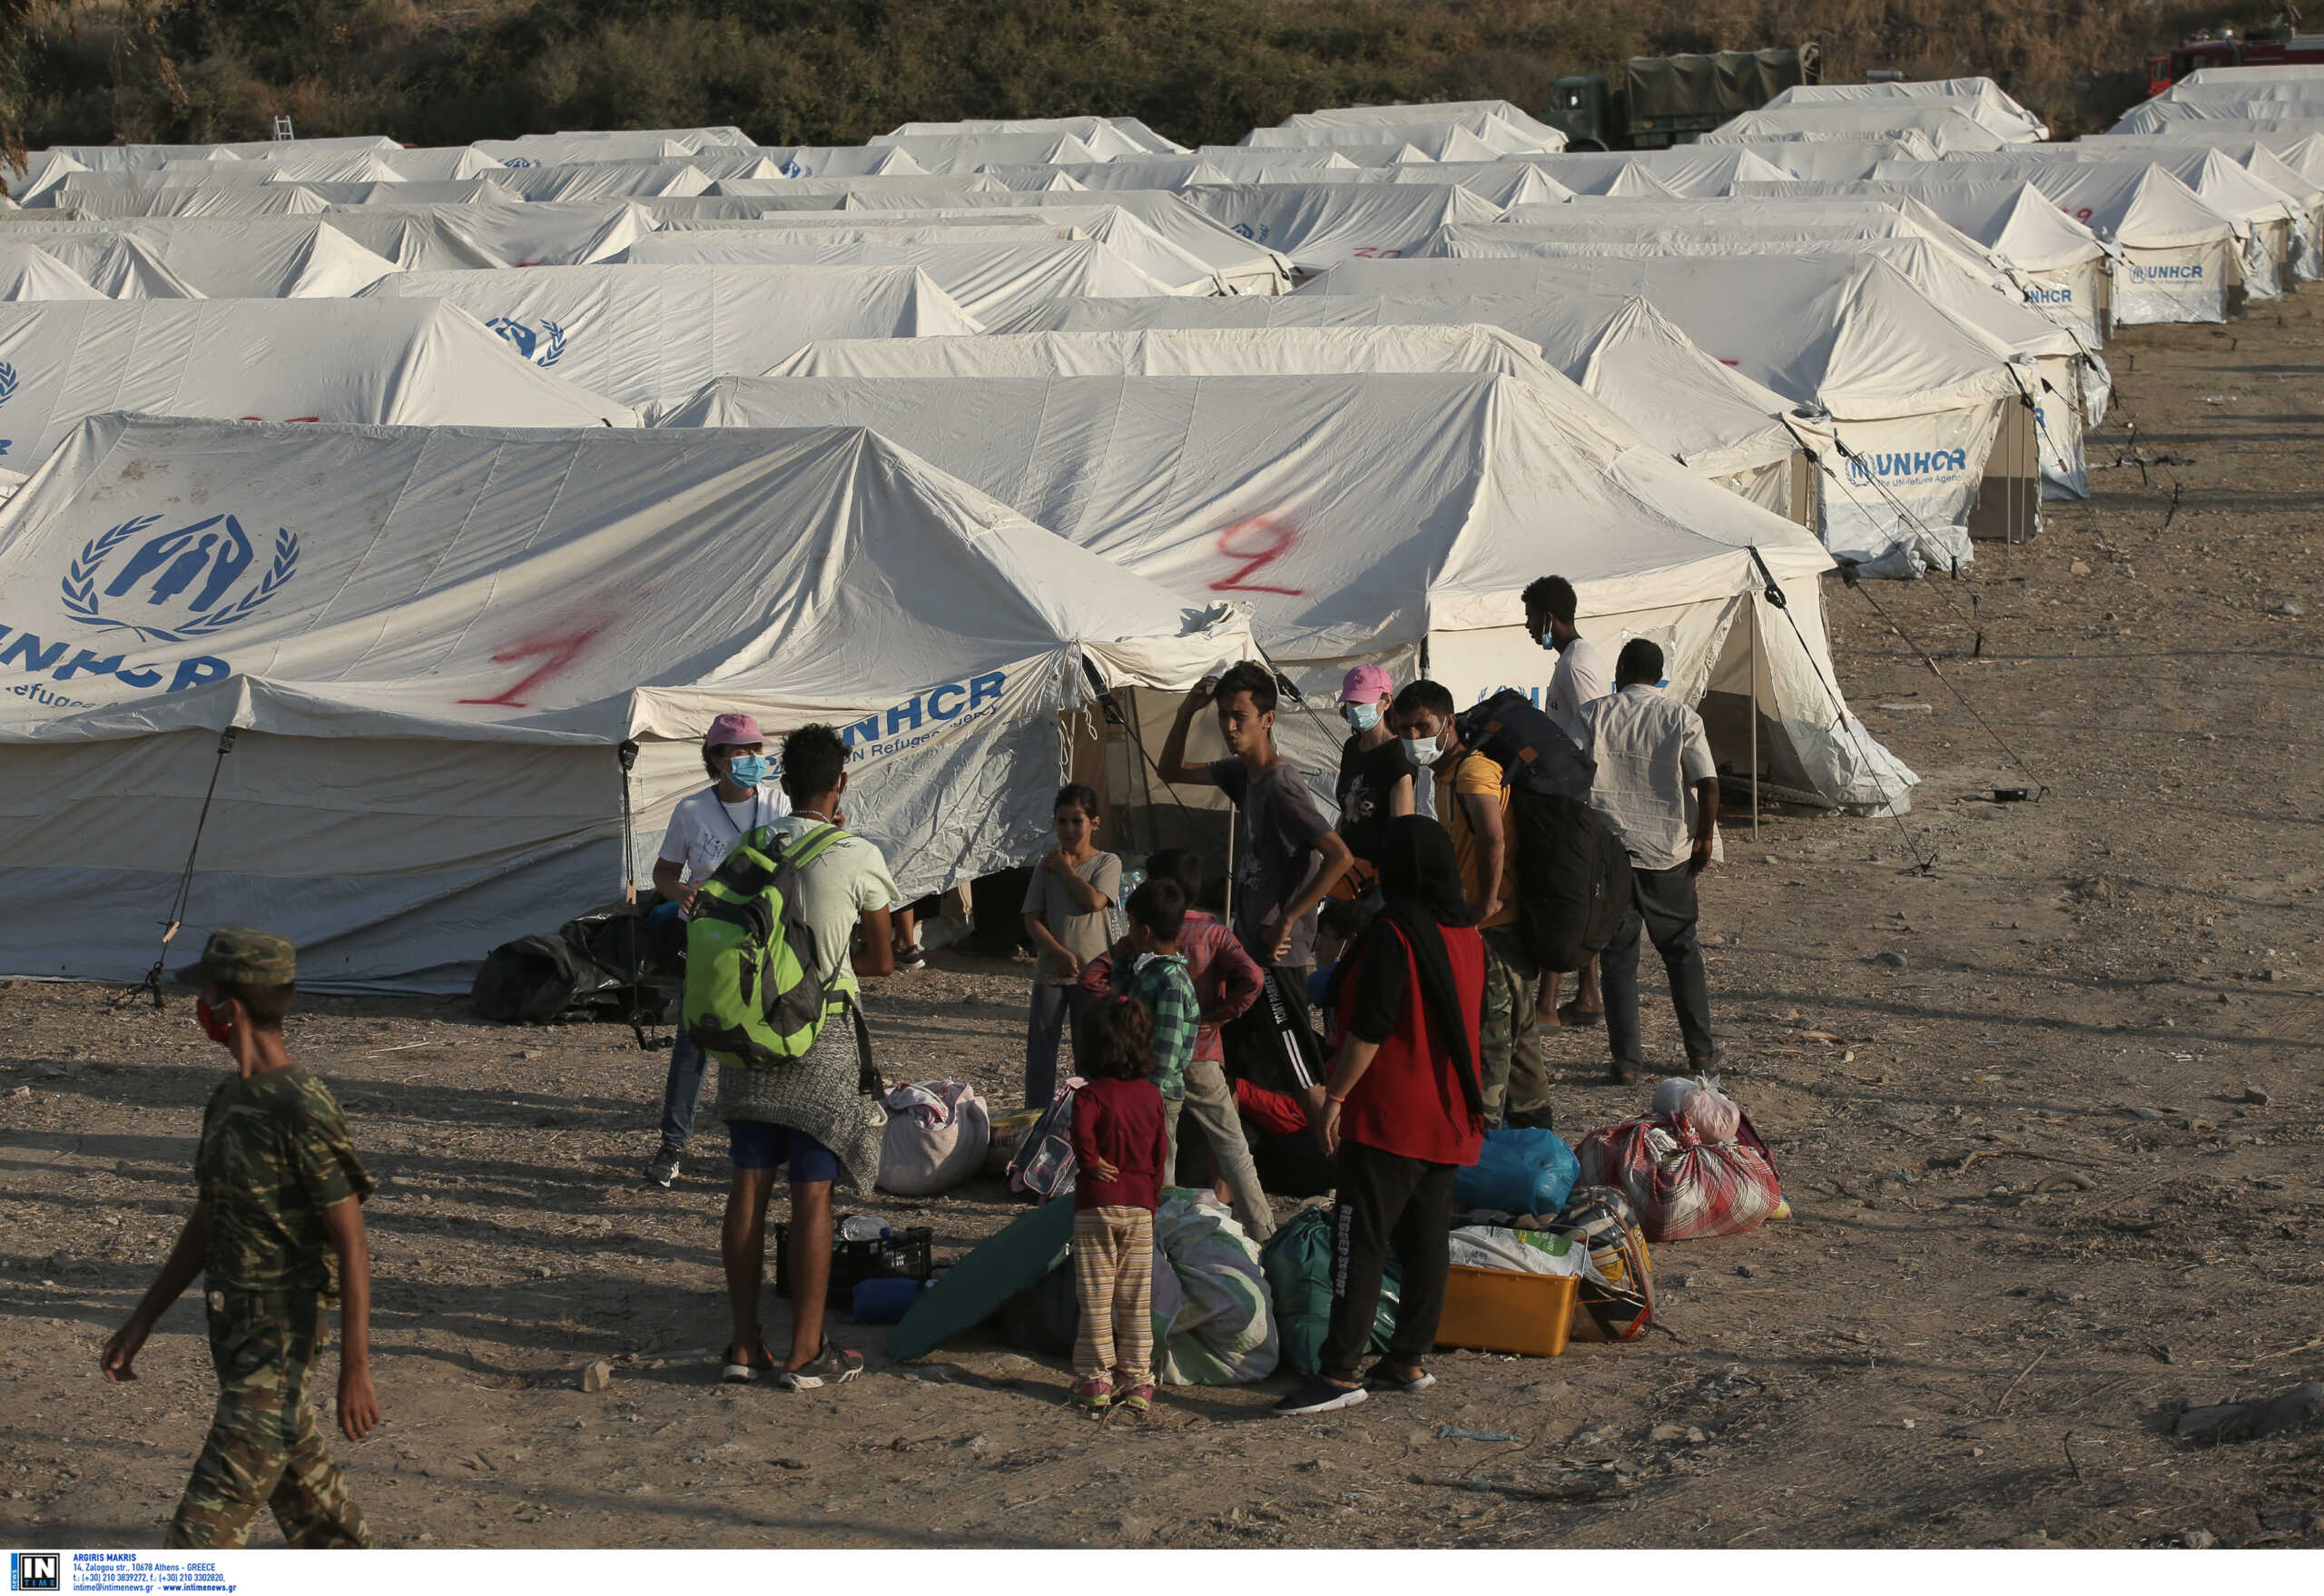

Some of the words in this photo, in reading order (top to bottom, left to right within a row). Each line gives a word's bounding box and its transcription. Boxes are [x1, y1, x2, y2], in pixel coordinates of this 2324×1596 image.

[2148, 266, 2202, 278] UNHCR
[2024, 290, 2072, 303] NHCR
[1876, 448, 1966, 477] UNHCR
[0, 624, 231, 694] NHCR
[842, 671, 1006, 746] NHCR
